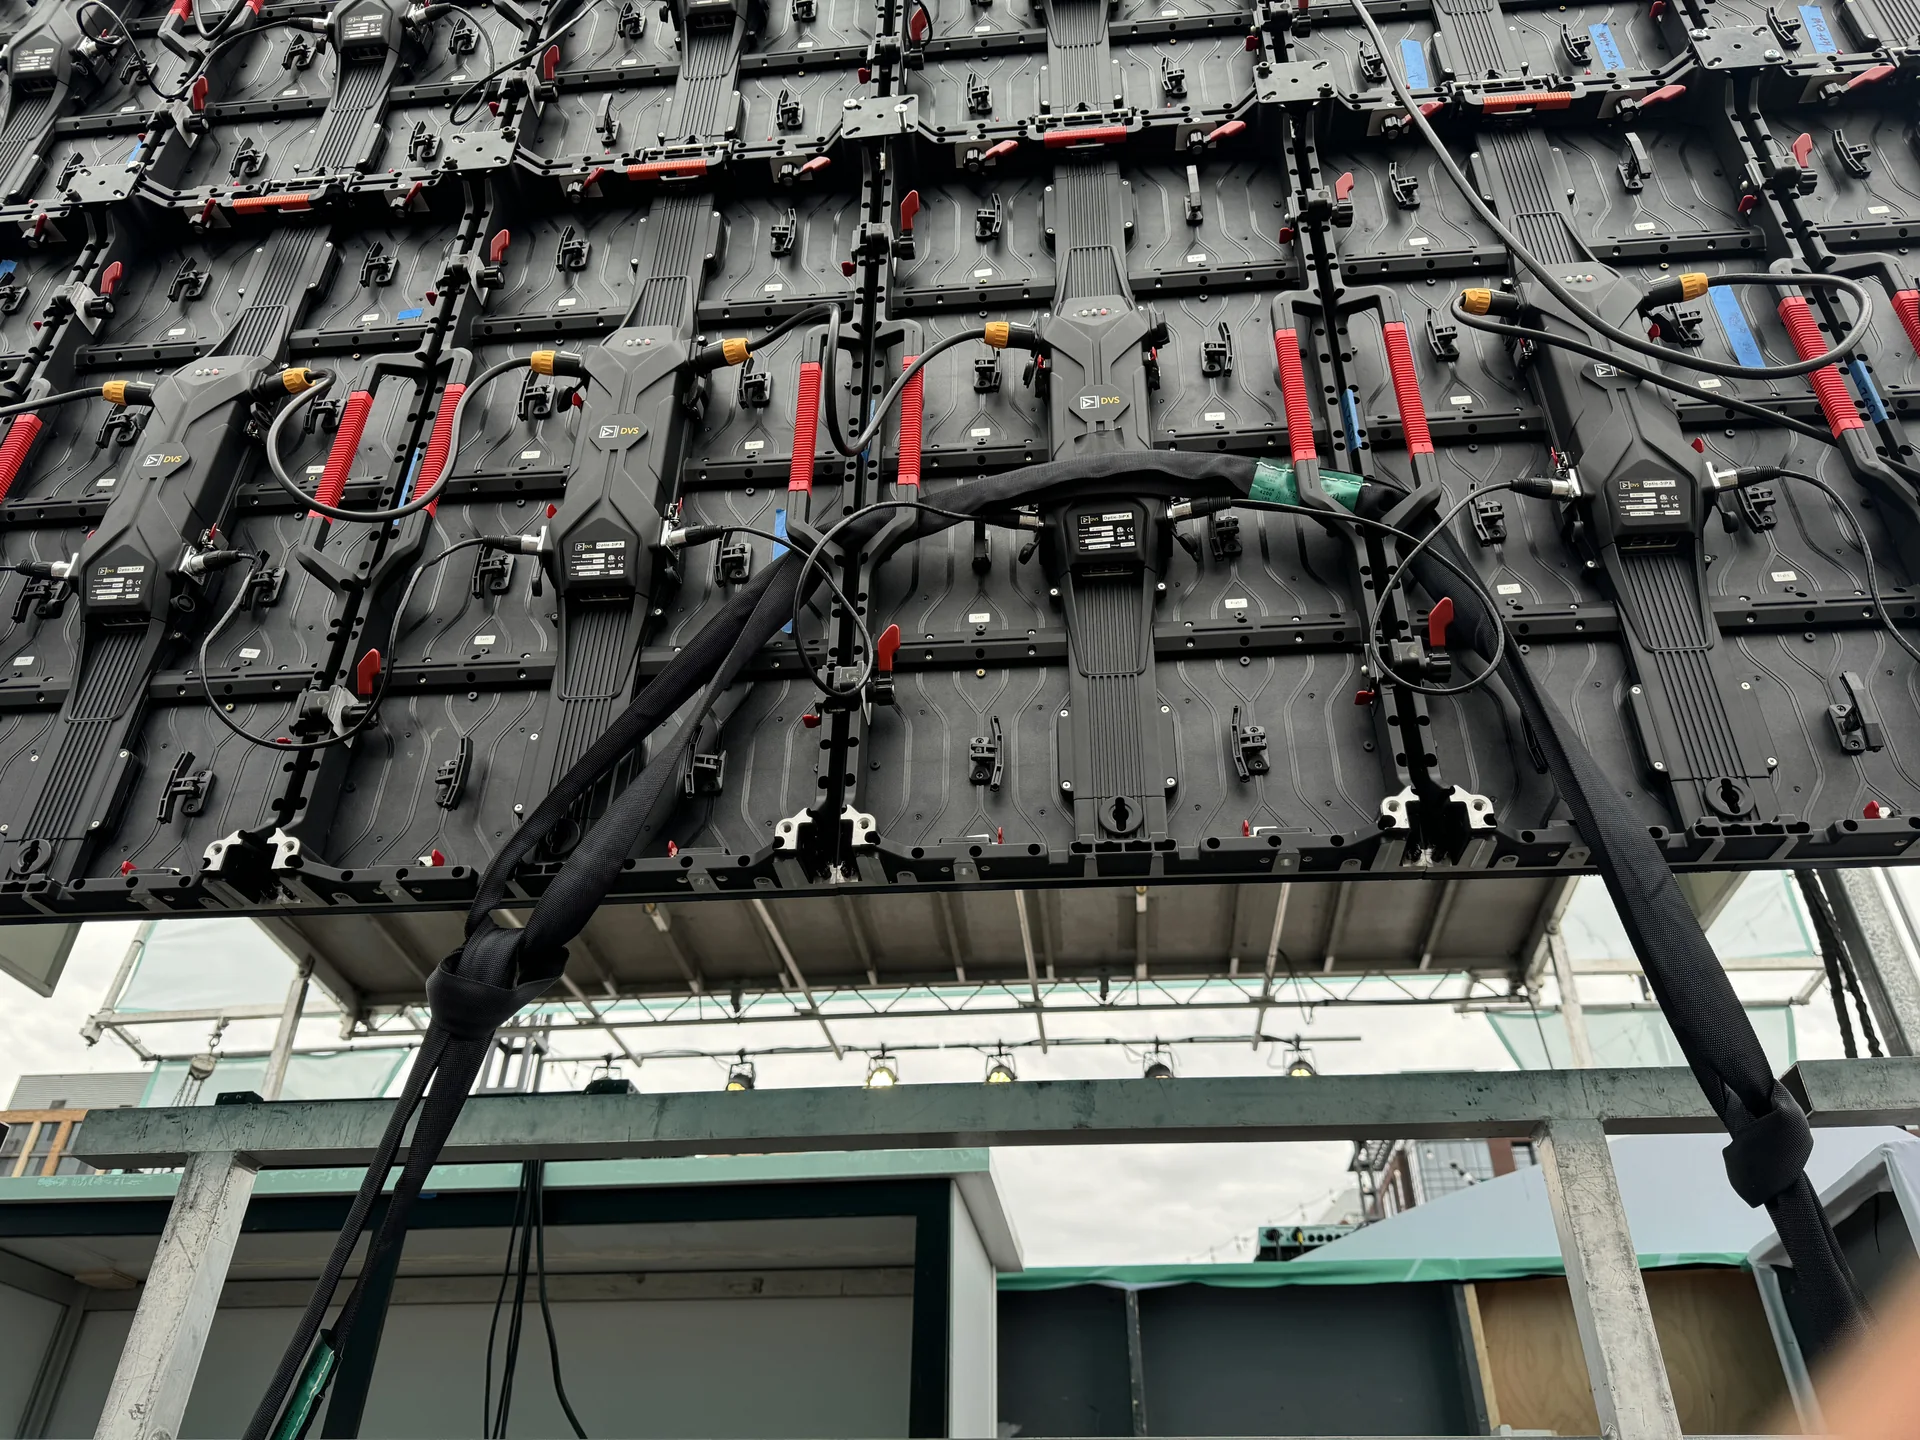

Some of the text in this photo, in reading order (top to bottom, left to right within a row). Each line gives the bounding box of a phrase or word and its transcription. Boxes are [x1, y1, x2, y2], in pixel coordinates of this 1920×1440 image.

[1100, 396, 1120, 405] DVS
[620, 426, 639, 435] DVS
[163, 455, 182, 463] DVS
